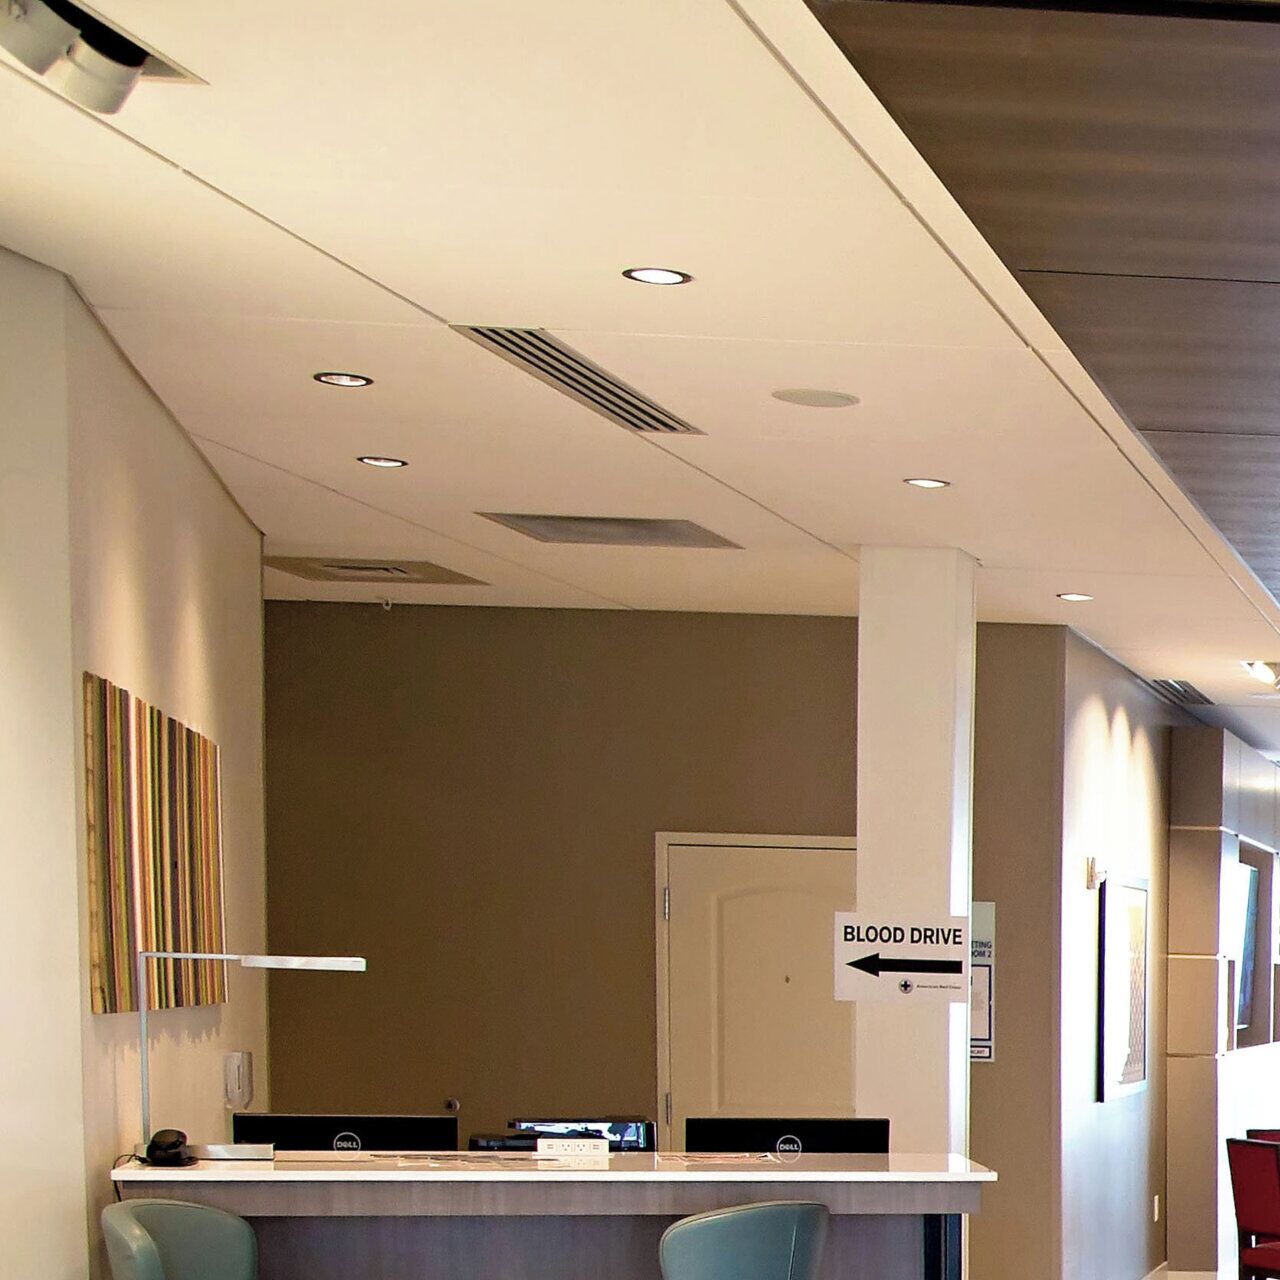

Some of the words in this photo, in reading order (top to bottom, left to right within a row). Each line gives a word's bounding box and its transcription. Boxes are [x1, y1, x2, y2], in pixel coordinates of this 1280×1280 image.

[843, 925, 905, 944] BLOOD
[910, 927, 963, 945] DRIVE
[987, 950, 992, 958] 2
[780, 1143, 799, 1151] DELL
